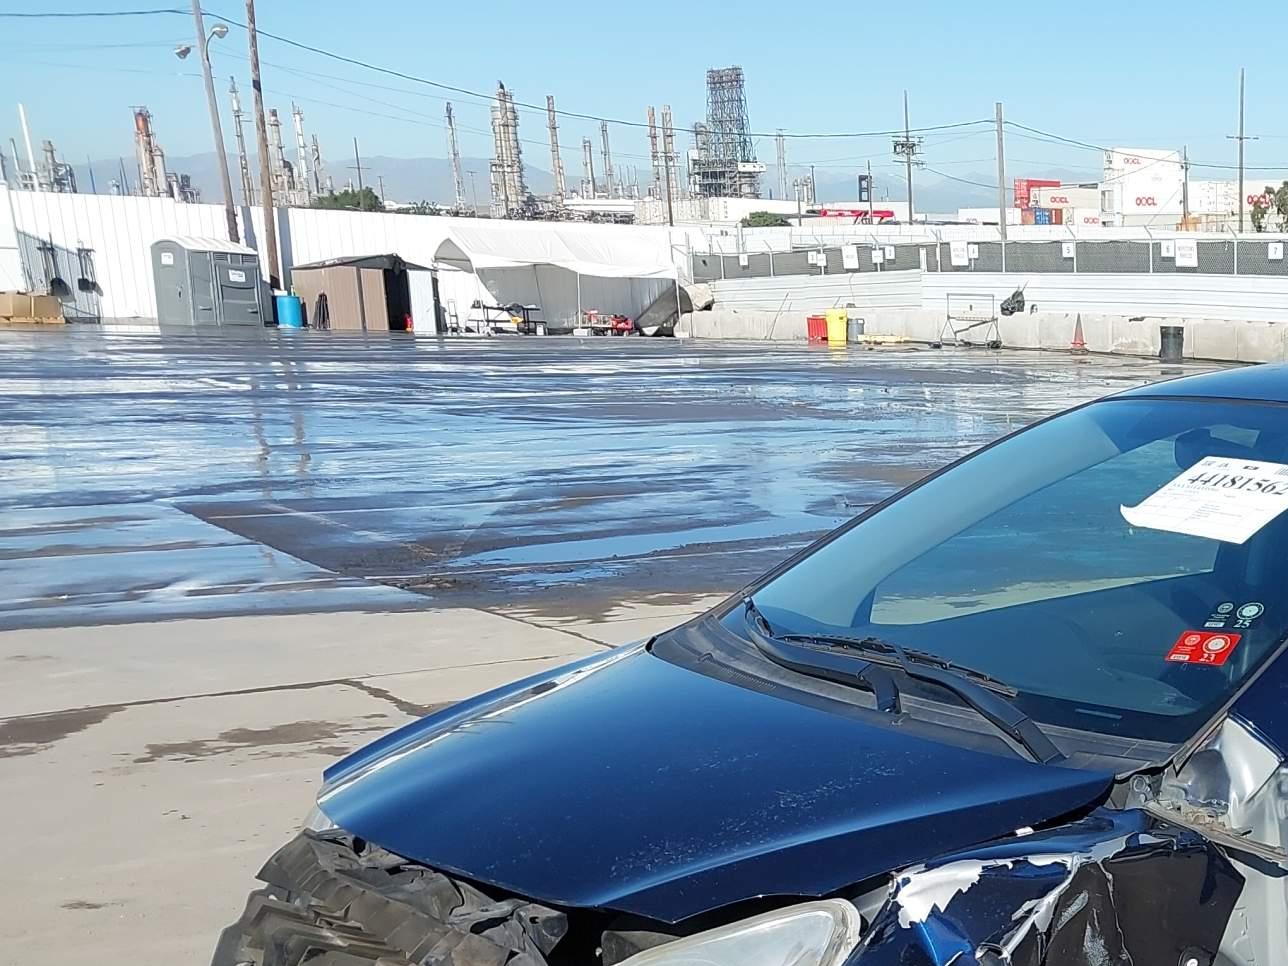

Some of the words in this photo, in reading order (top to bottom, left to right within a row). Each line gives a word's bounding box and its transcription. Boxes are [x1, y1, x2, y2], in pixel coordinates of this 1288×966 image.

[1050, 196, 1069, 204] OOCL
[1135, 196, 1158, 207] OOCL
[1273, 246, 1279, 255] 7
[1233, 619, 1252, 629] 25
